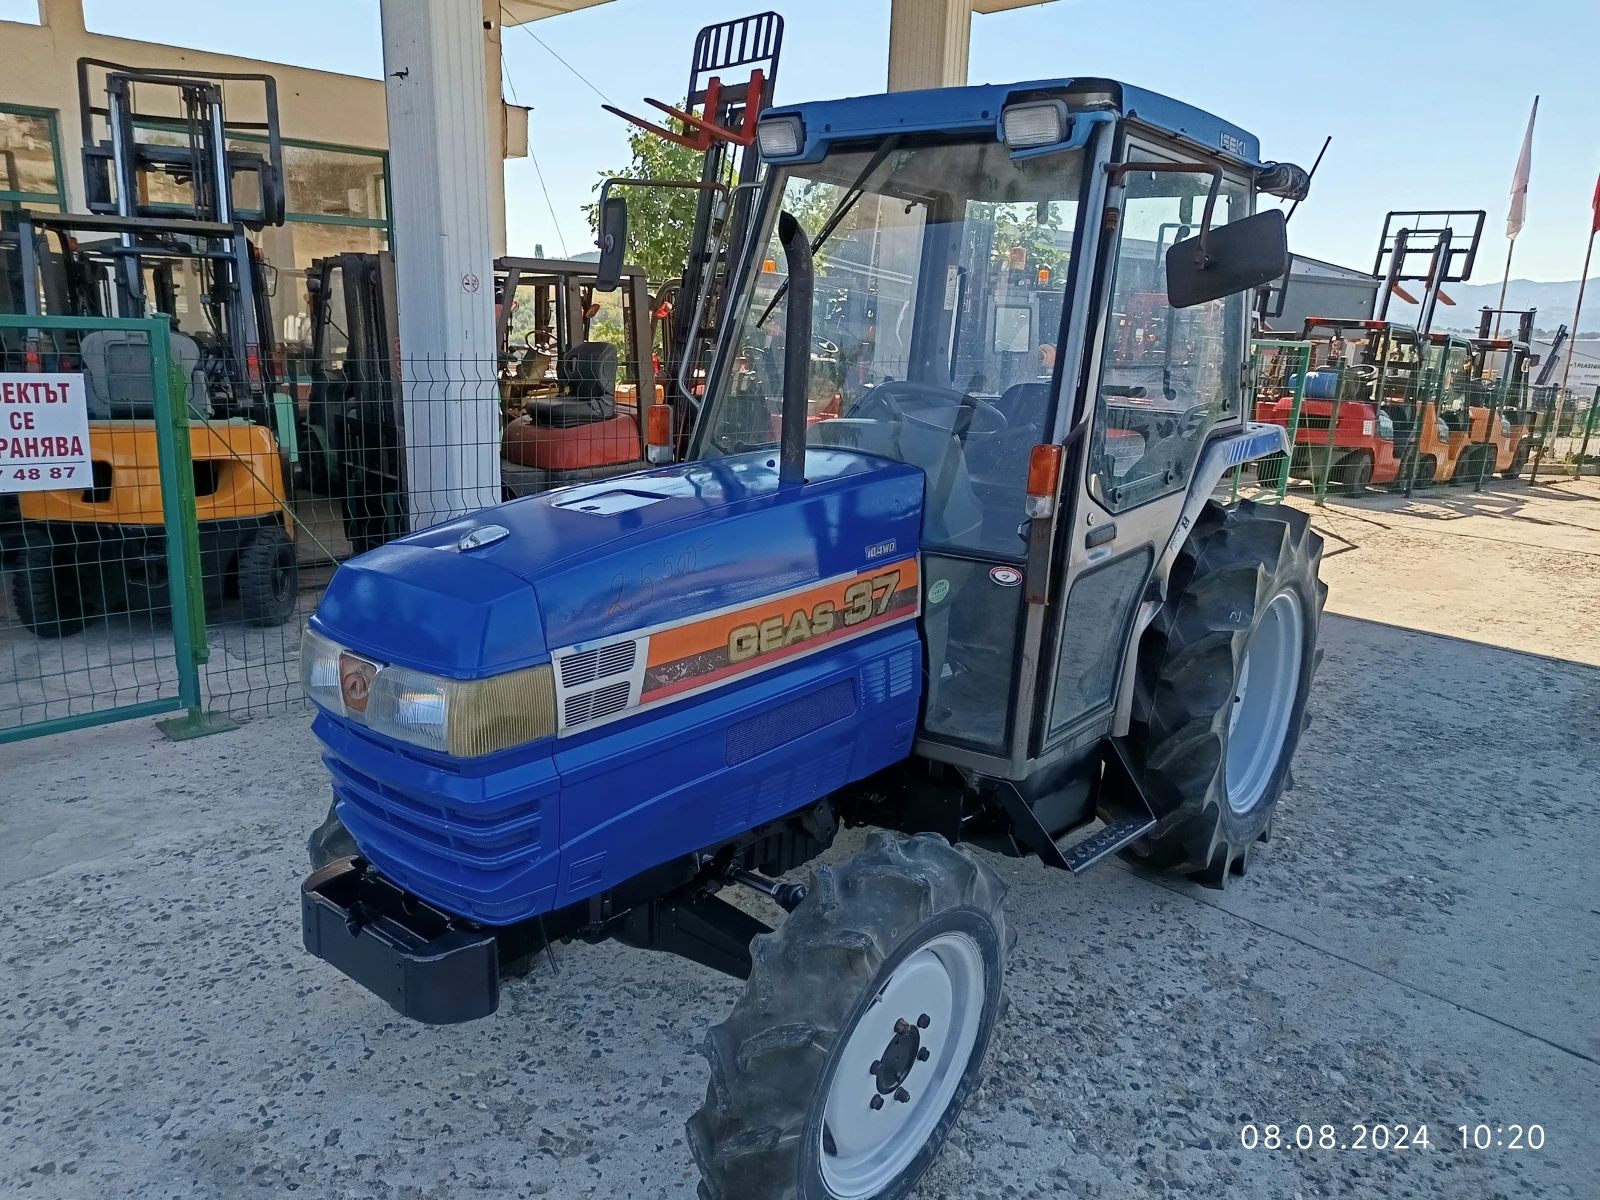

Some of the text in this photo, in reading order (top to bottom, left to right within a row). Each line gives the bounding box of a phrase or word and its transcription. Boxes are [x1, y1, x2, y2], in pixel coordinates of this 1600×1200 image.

[1220, 132, 1246, 157] ISEKI
[0, 382, 70, 404] ЕКТЪТ
[9, 411, 35, 430] СЕ
[12, 467, 41, 481] 48
[49, 466, 76, 479] 87
[728, 569, 901, 663] GEAS 37
